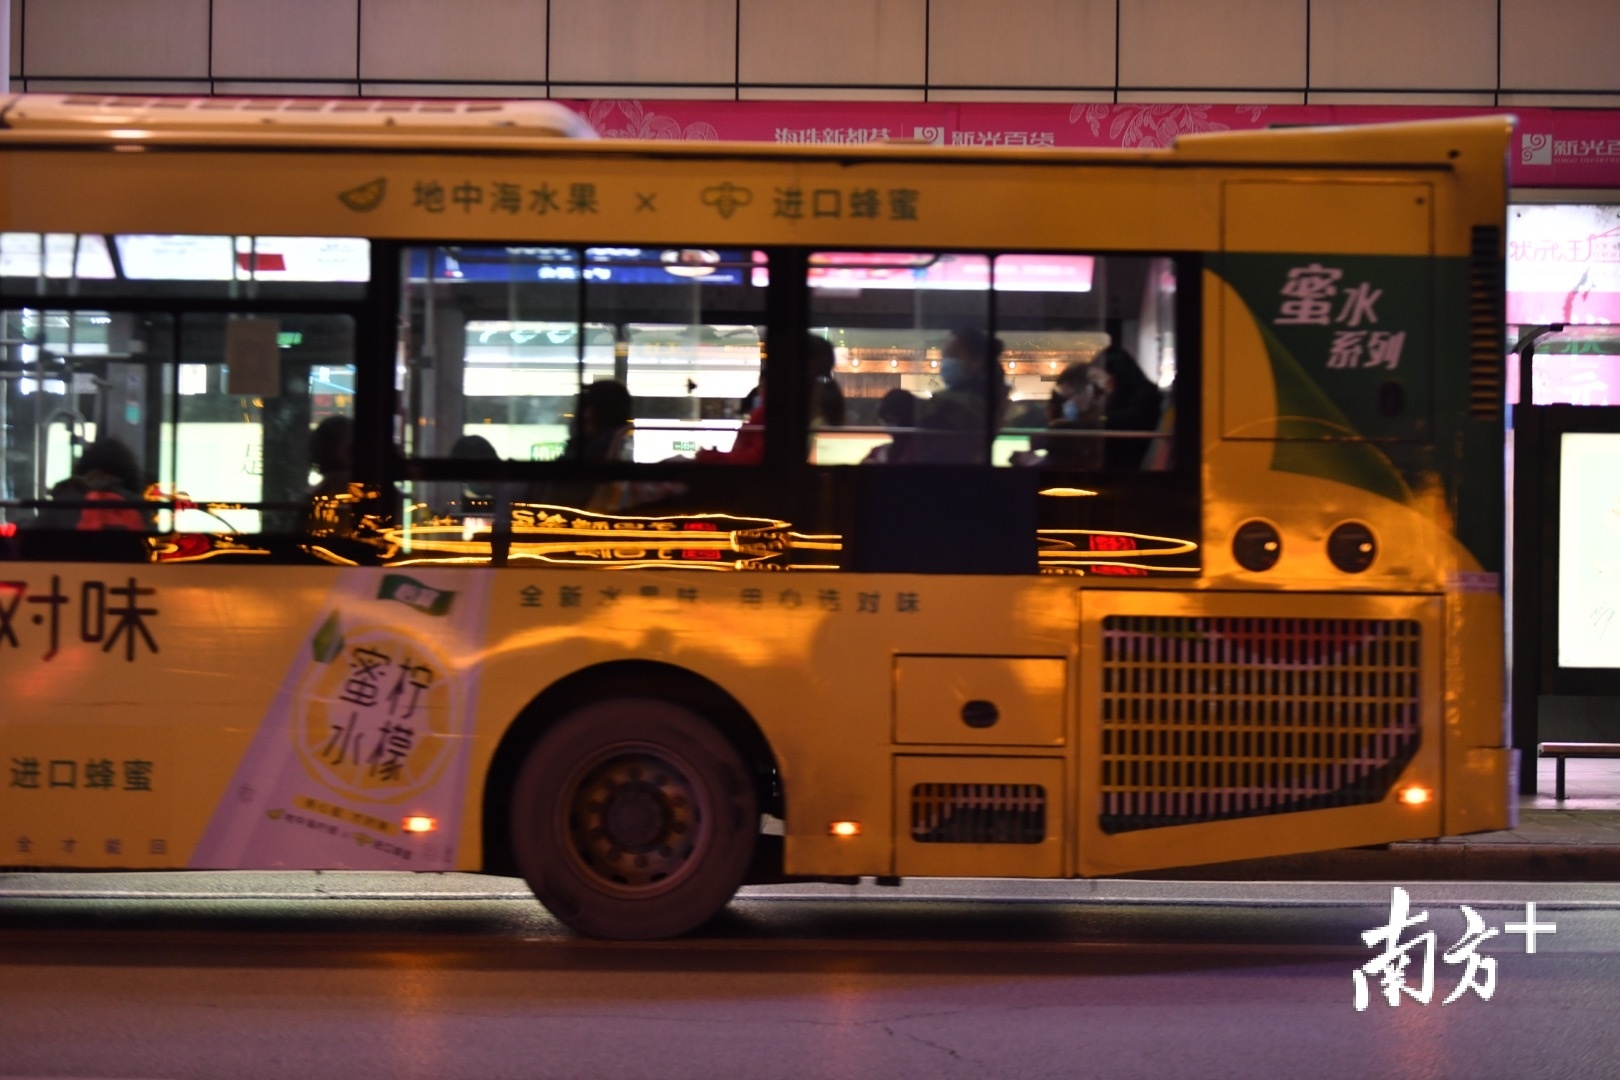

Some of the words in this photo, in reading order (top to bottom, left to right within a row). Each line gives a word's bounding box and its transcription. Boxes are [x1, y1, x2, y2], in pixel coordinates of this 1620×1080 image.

[412, 181, 600, 216] 地中海水果
[773, 187, 920, 222] 进口蜂蜜
[1273, 262, 1383, 327] 蜜水
[1326, 330, 1407, 370] 系列
[0, 574, 160, 662] 对味
[10, 757, 154, 791] 进口蜂蜜
